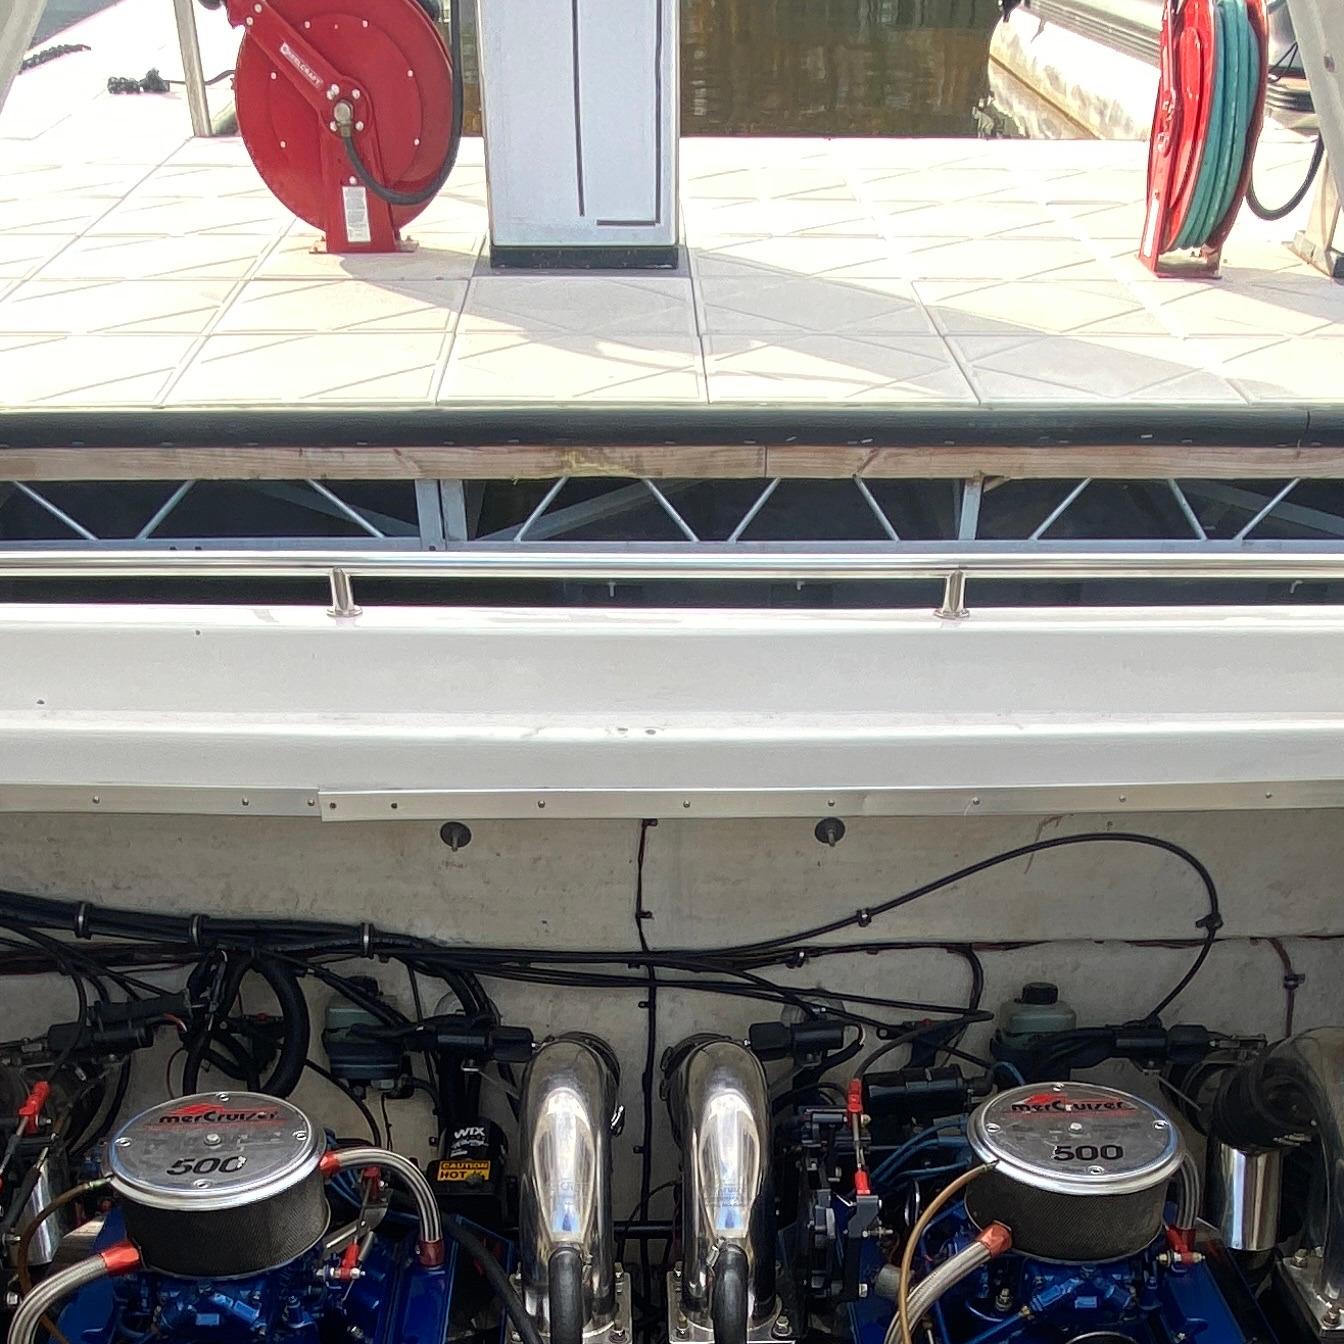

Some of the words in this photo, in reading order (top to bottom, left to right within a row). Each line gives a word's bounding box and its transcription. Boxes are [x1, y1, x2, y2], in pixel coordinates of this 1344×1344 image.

[453, 1126, 486, 1139] WIX
[1052, 1144, 1124, 1161] 500
[166, 1155, 247, 1176] 500
[441, 1162, 489, 1170] CAUTION
[440, 1170, 467, 1179] HOT
